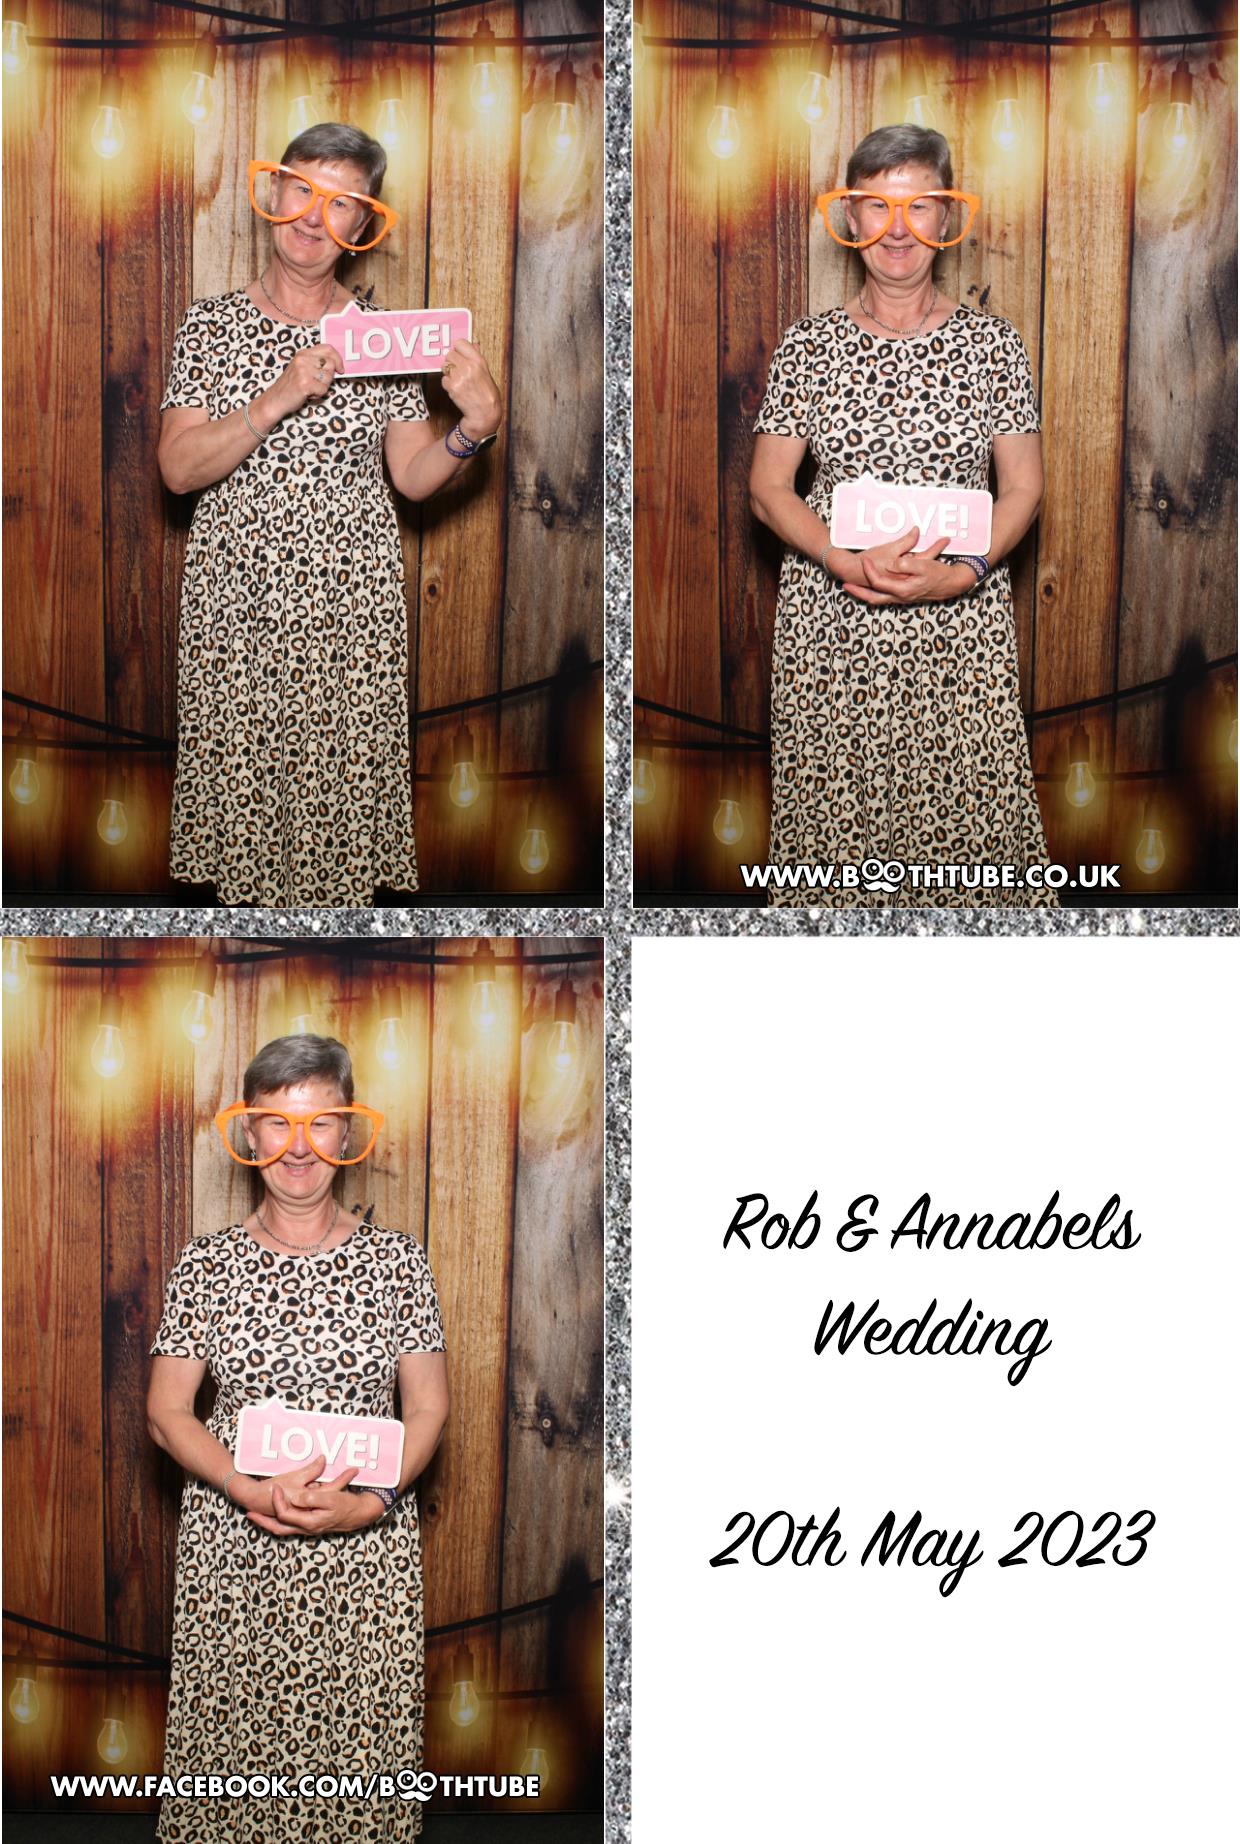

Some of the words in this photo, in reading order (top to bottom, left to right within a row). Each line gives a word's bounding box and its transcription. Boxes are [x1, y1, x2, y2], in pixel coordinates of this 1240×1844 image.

[344, 323, 451, 362] LOVE!
[855, 499, 970, 541] LOVE!
[260, 1423, 381, 1471] LOVE!
